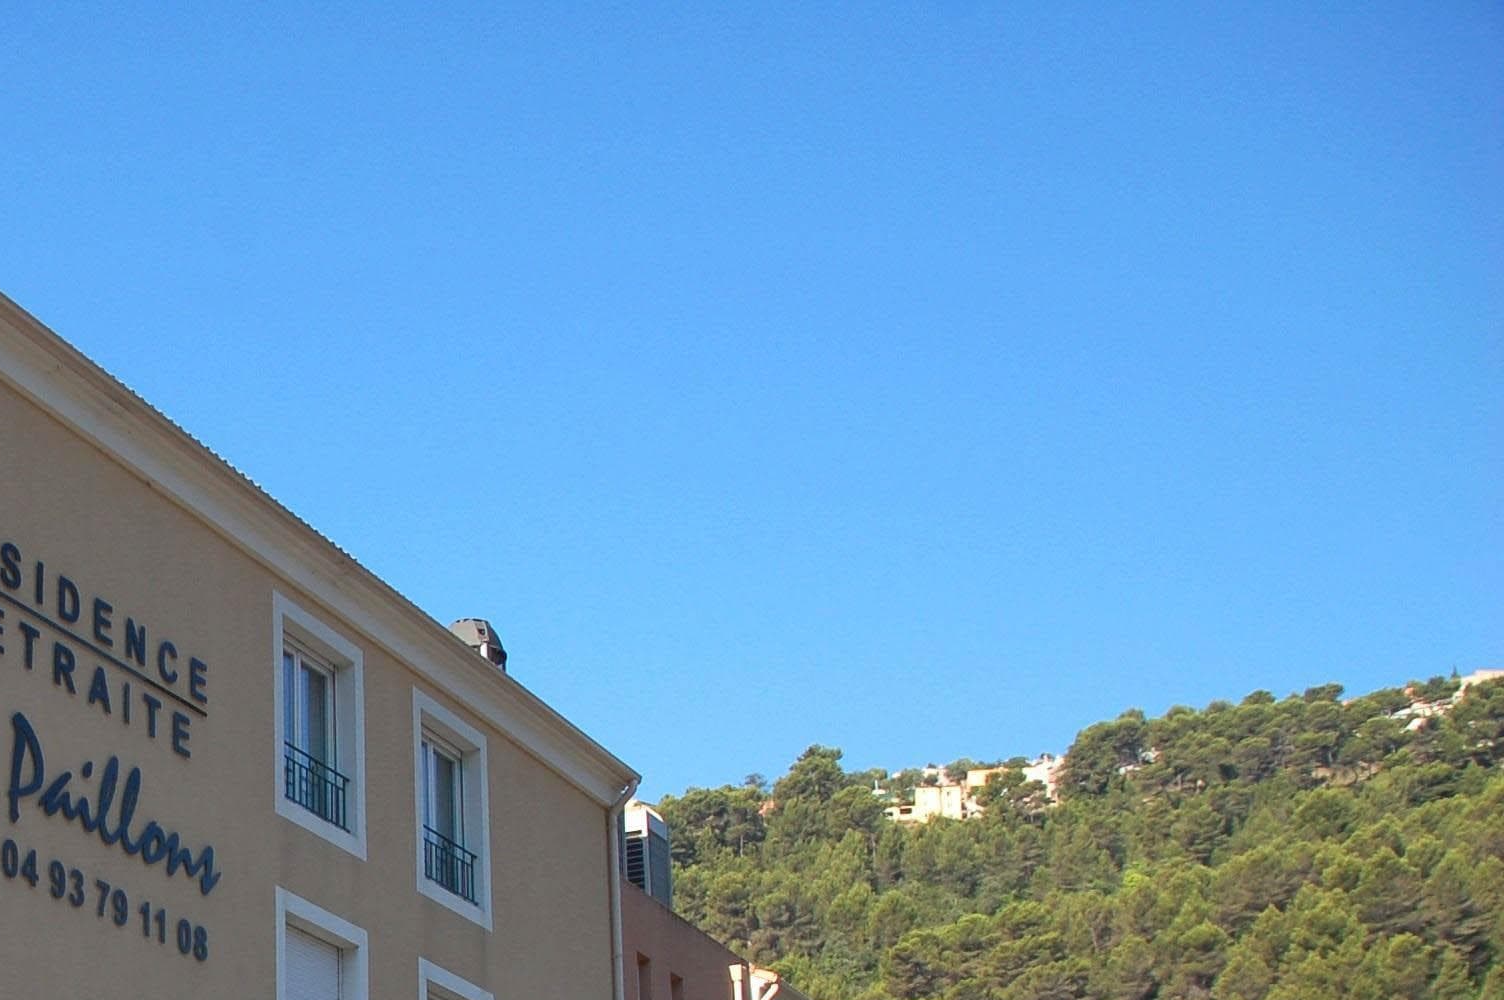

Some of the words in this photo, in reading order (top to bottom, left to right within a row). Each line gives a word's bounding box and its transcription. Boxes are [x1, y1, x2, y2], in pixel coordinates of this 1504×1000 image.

[7, 711, 221, 895] Paillons
[2, 839, 39, 887] 04
[50, 860, 85, 907] 93
[96, 879, 128, 926] 79
[139, 901, 166, 944] 11
[177, 918, 208, 961] 08
